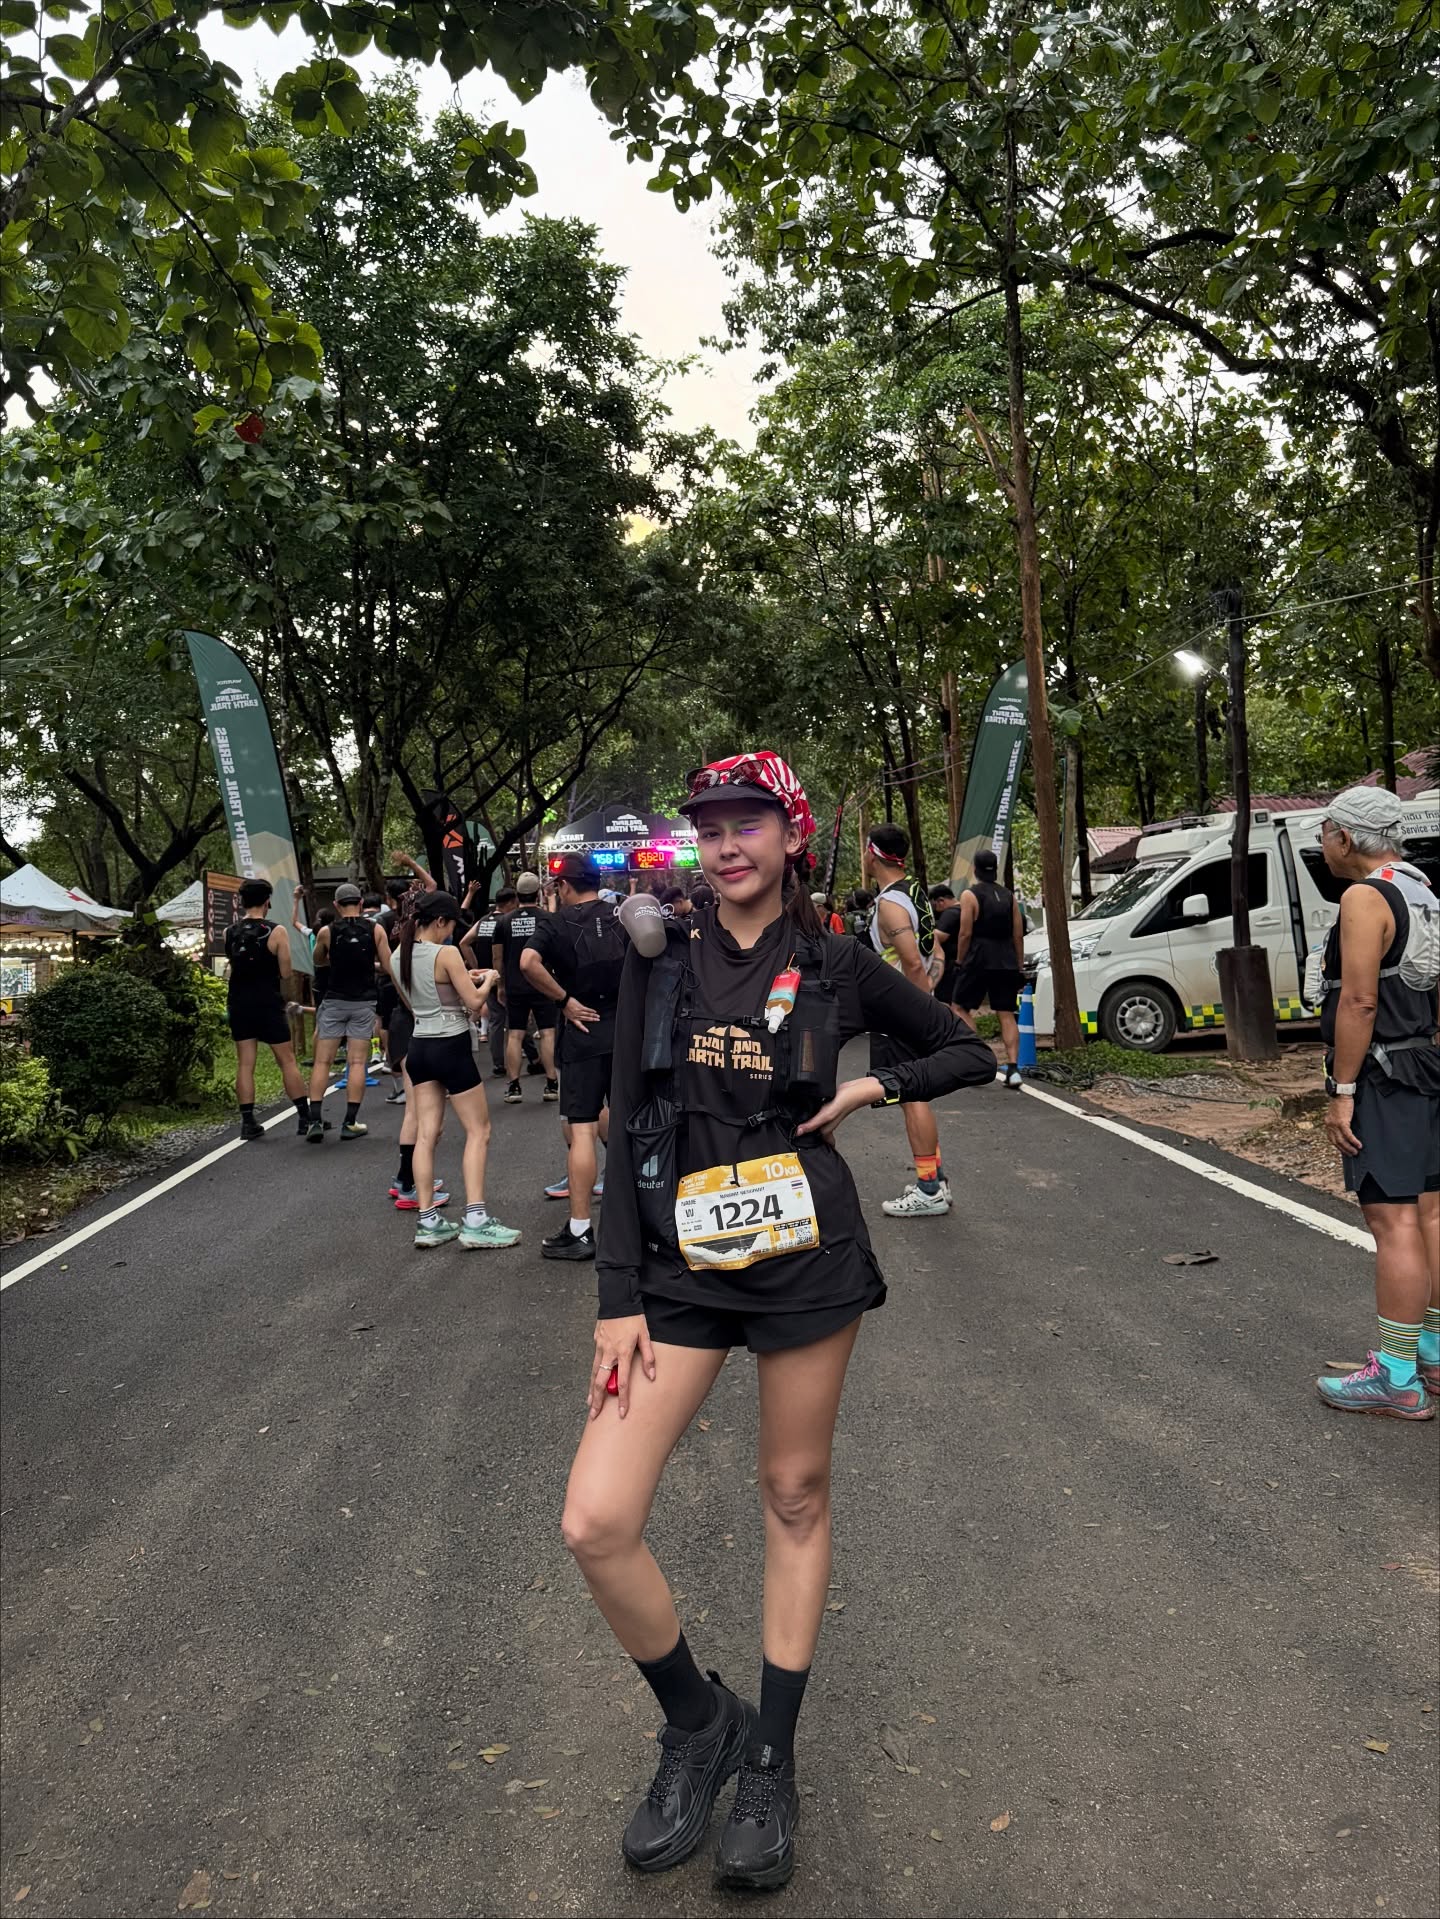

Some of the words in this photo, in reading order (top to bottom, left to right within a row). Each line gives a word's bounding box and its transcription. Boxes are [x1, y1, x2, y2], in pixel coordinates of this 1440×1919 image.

[997, 785, 1012, 821] TRAIL
[1400, 824, 1428, 835] Service
[693, 1034, 761, 1054] THAIAND
[685, 1047, 725, 1069] ARTH
[732, 1054, 774, 1071] TRAIL
[638, 1181, 665, 1189] deuter
[709, 1193, 784, 1231] 1224
